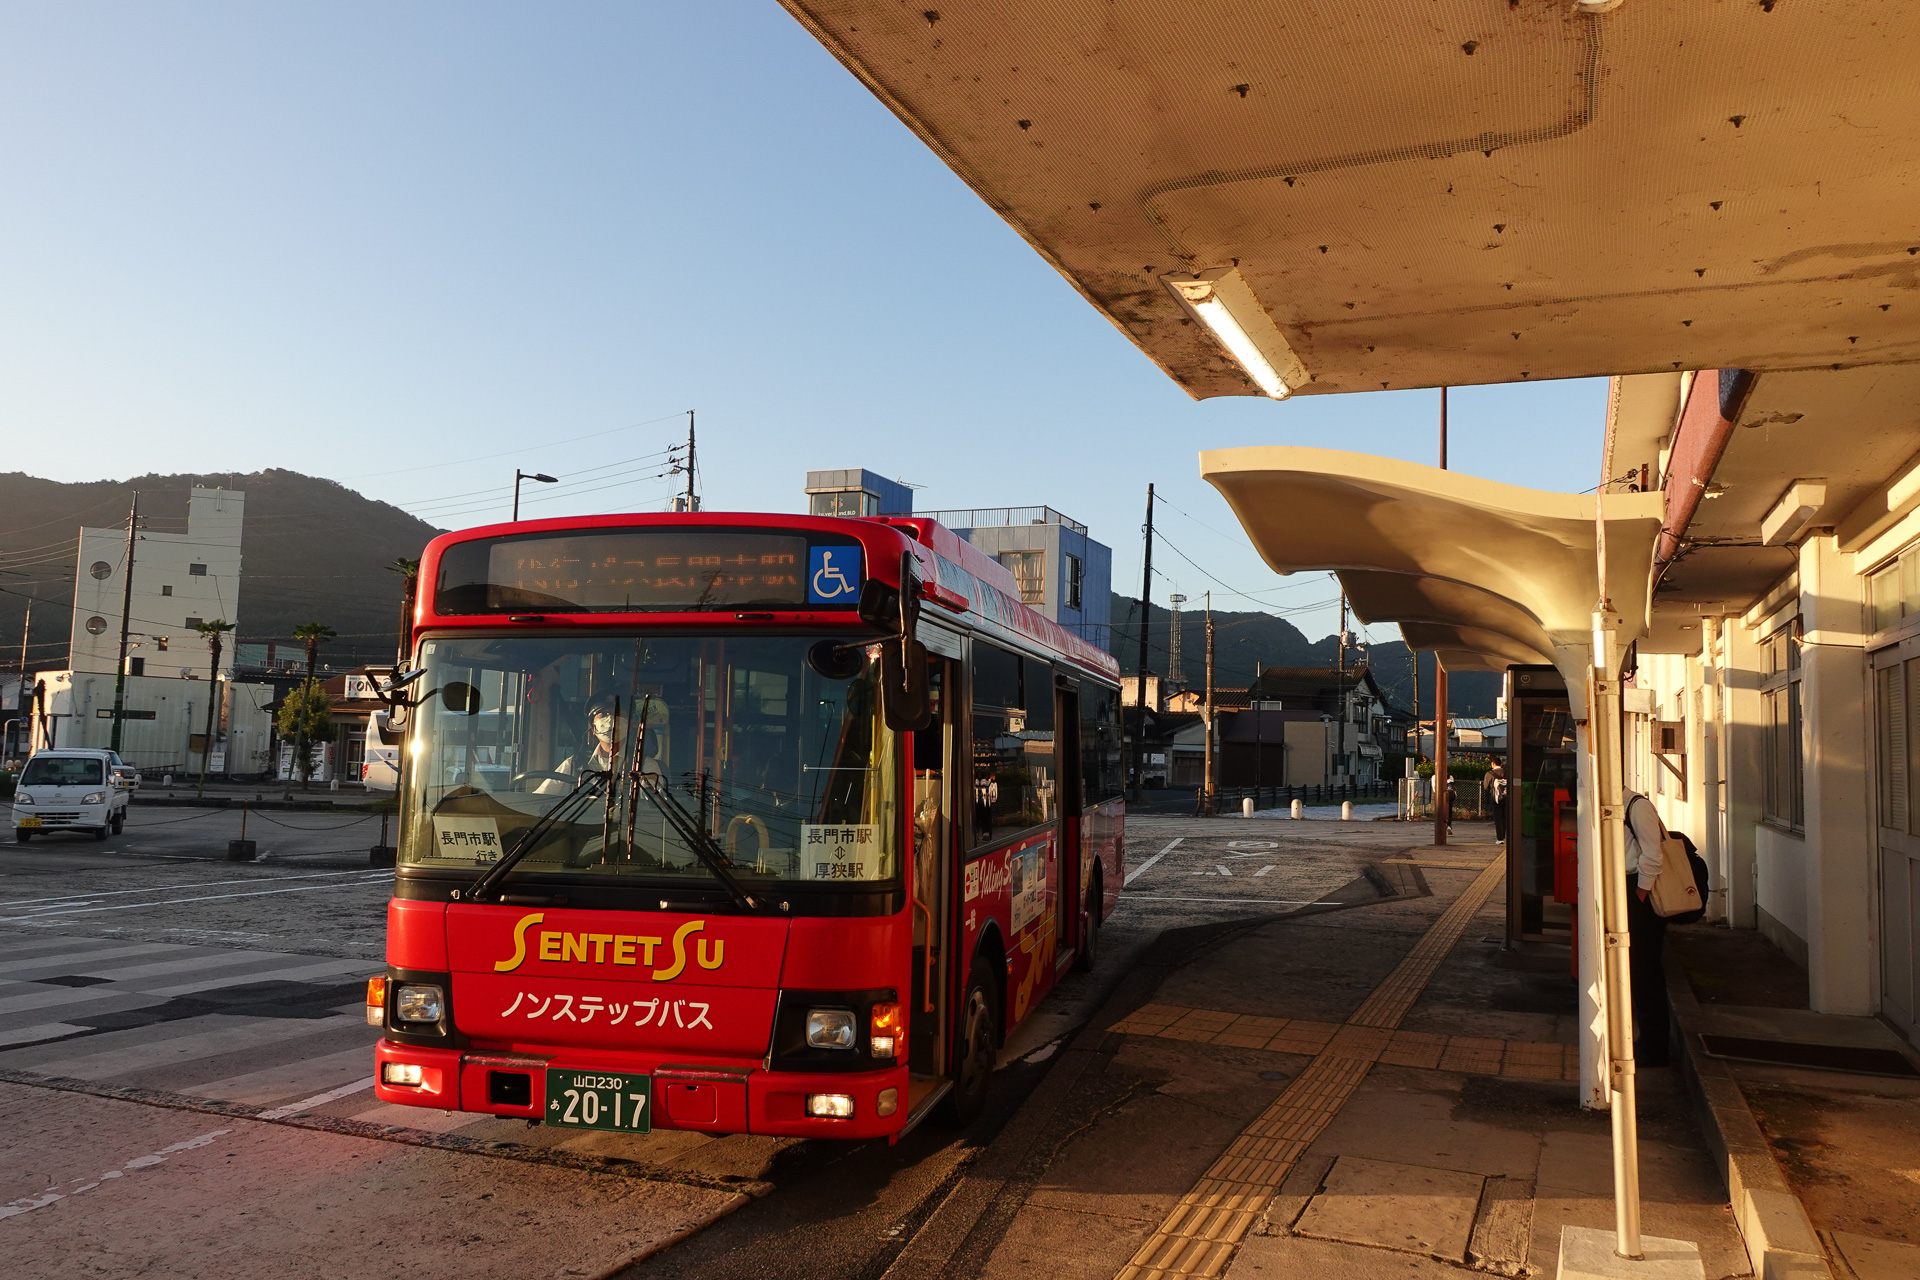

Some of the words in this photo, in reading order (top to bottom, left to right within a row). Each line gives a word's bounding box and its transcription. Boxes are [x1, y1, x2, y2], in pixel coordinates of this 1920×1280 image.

[441, 831, 498, 847] 長門市駅
[807, 828, 873, 845] 長門市駅
[476, 849, 498, 862] 行き
[814, 862, 864, 879] 厚狭駅
[494, 912, 725, 982] SENTETSU
[502, 991, 713, 1031] ノンステップバス
[563, 1089, 646, 1128] 20-17
